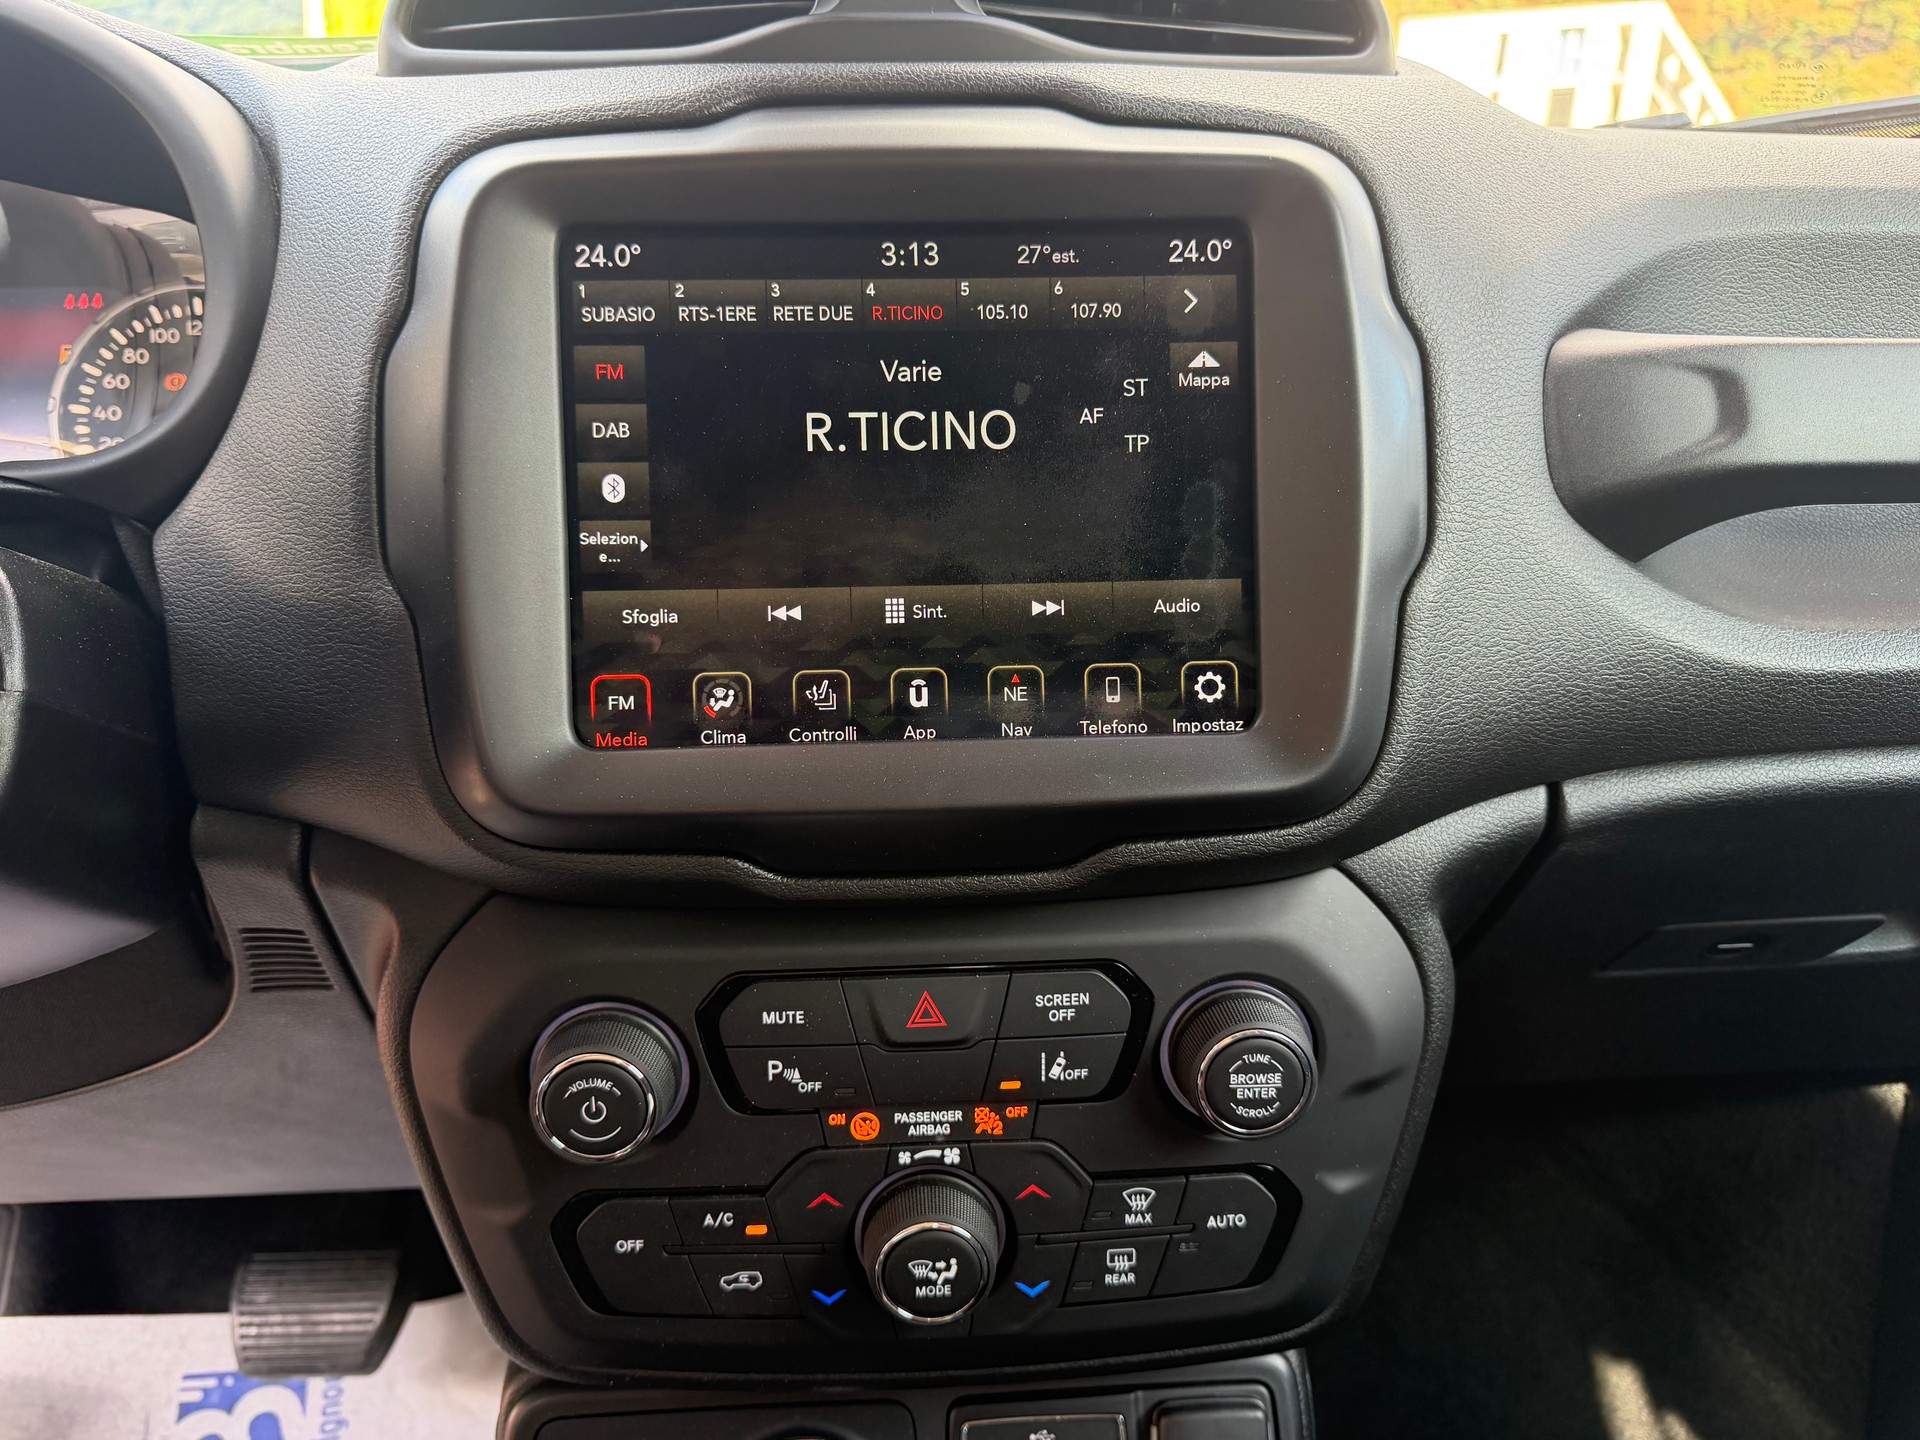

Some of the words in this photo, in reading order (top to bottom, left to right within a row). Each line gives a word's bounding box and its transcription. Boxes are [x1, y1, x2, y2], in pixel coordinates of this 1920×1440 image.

[575, 244, 642, 269] 24.0°
[881, 242, 939, 267] 3:13
[1169, 239, 1232, 263] 24.0°
[578, 284, 586, 299] 1
[675, 284, 685, 298] 2
[771, 283, 780, 297] 3
[866, 283, 875, 297] 4
[960, 282, 970, 296] 5
[1054, 281, 1063, 295] 6
[581, 307, 656, 323] SUBASIO
[679, 306, 757, 322] RTS-1ERE
[773, 306, 814, 322] RETE
[818, 306, 854, 321] DUE
[872, 305, 943, 321] R.TICINO
[976, 304, 1029, 320] 105.10
[1070, 303, 1122, 319] 107.90
[149, 327, 181, 344] 100
[122, 347, 150, 365] 80
[596, 364, 624, 381] FM
[880, 360, 942, 382] Varie
[102, 373, 131, 390] 60
[1123, 378, 1148, 397] ST
[1178, 373, 1230, 390] Mappa
[93, 404, 123, 421] 40
[1079, 408, 1104, 425] AF
[592, 422, 630, 439] DAB
[805, 410, 1017, 453] R.TICINO
[1124, 435, 1150, 453] TP
[579, 532, 638, 547] Selezion
[912, 604, 948, 620] Sint.
[1154, 599, 1200, 614] Audio
[622, 609, 679, 627] Sfoglia
[1003, 686, 1028, 702] NE
[608, 695, 635, 711] FM
[904, 725, 936, 740] App
[1001, 722, 1033, 737] Nav
[1079, 720, 1148, 736] Telefono
[1172, 718, 1244, 734] Impostaz
[596, 733, 648, 748] Media
[701, 730, 747, 745] Clima
[789, 726, 857, 743] Controlli
[1035, 993, 1090, 1008] SCREEN
[762, 1011, 805, 1025] MUTE
[1048, 1008, 1076, 1022] OFF
[1242, 1053, 1272, 1065] TUNE
[1065, 1068, 1089, 1081] OFF
[1229, 1072, 1282, 1085] BROWSE
[570, 1078, 614, 1093] VOLUME
[798, 1081, 823, 1093] OFF
[1236, 1086, 1277, 1099] ENTER
[894, 1110, 963, 1125] PASSENGER
[1005, 1106, 1029, 1119] OFF
[1235, 1104, 1276, 1118] SCROLL
[828, 1113, 846, 1126] ON
[907, 1123, 951, 1137] AIRBAG
[703, 1212, 735, 1229] A/C
[1124, 1212, 1153, 1225] MAX
[1206, 1213, 1246, 1229] AUTO
[615, 1239, 645, 1254] OFF
[1104, 1271, 1136, 1285] REAR
[915, 1283, 952, 1298] MODE
